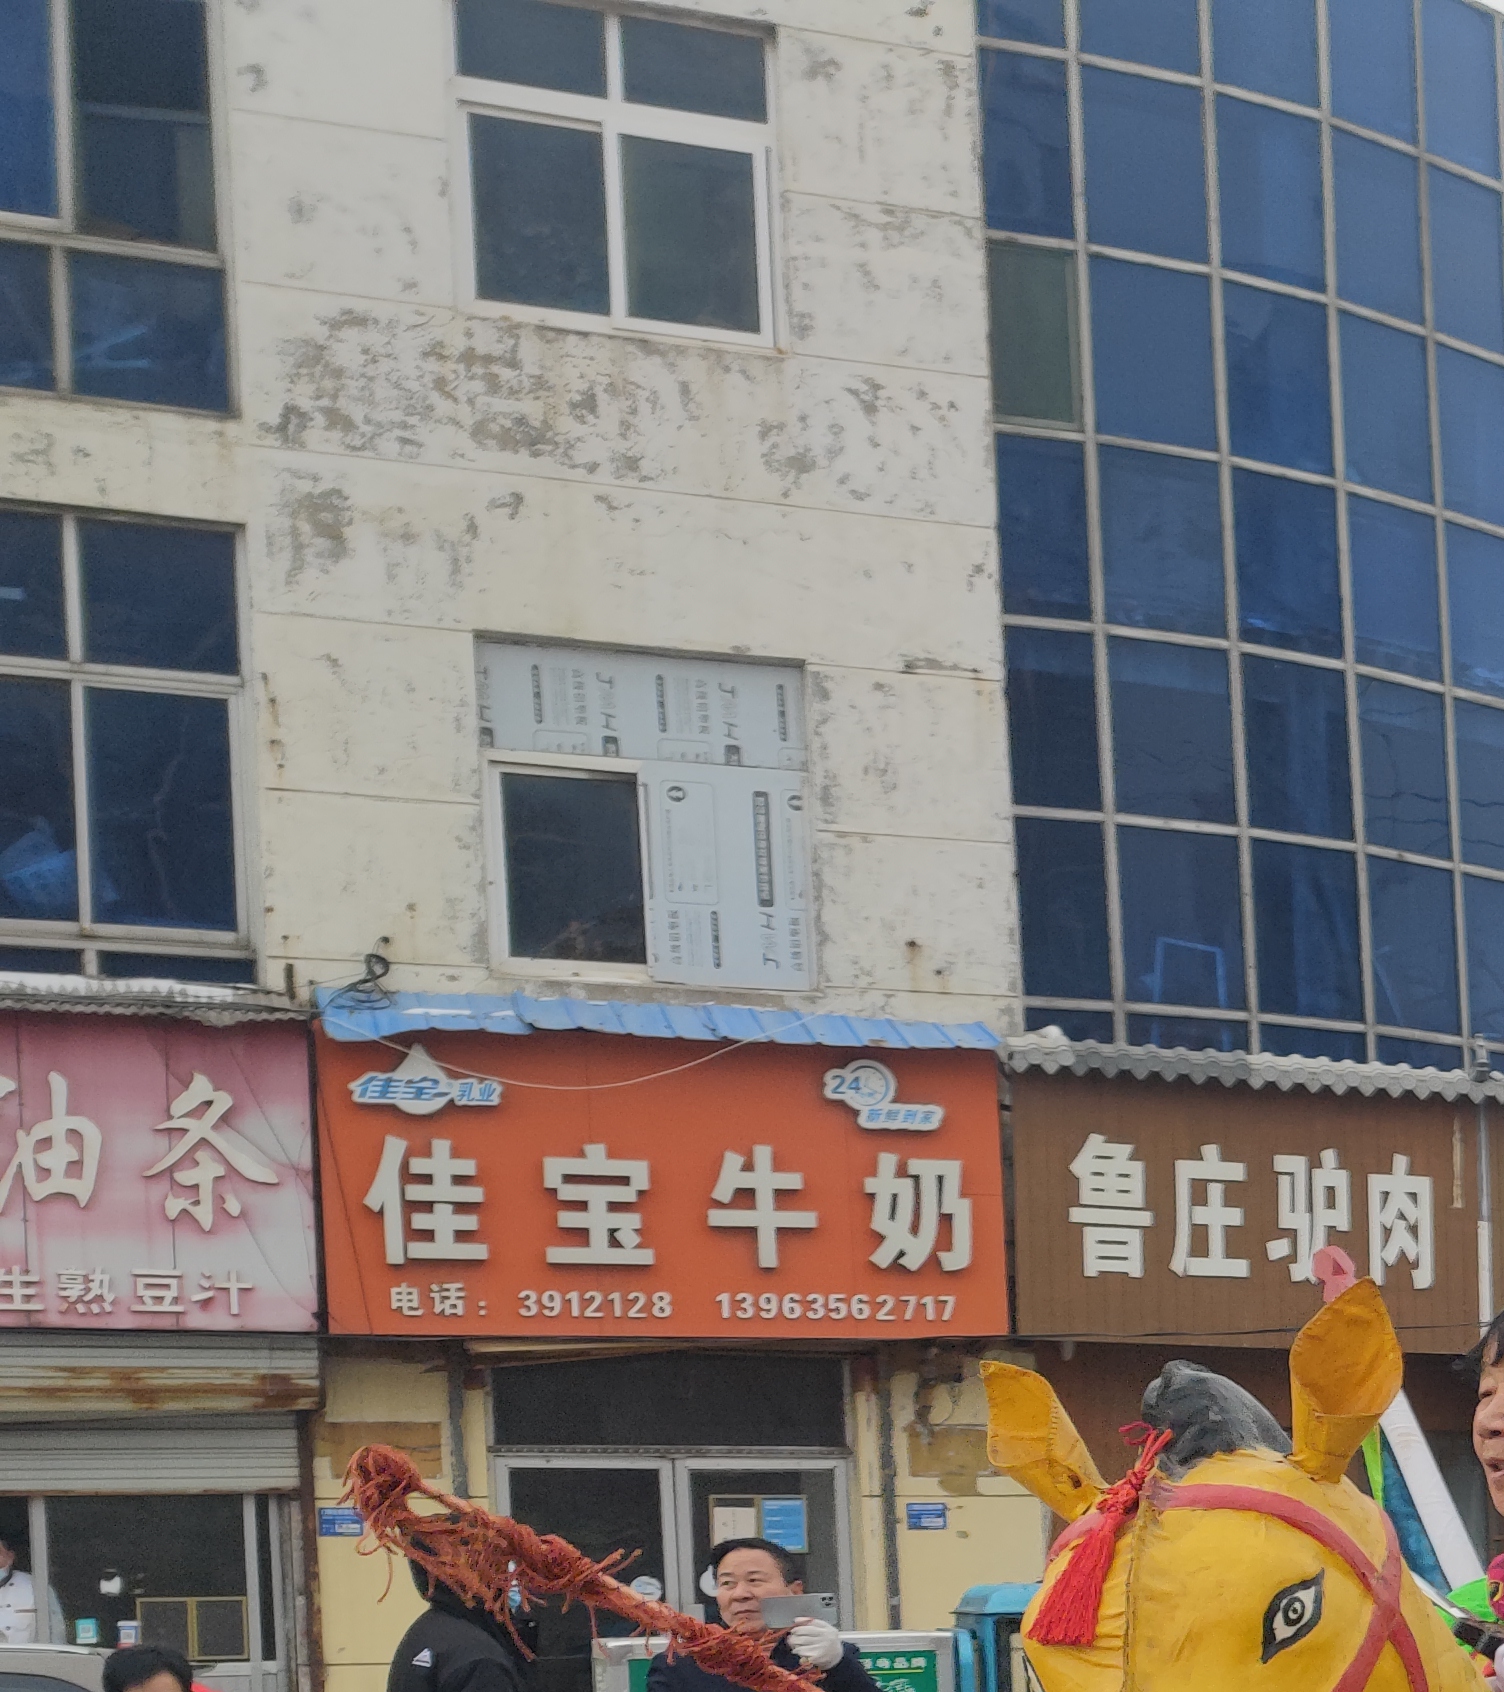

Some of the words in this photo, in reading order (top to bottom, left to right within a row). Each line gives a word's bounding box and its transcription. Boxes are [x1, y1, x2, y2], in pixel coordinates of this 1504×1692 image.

[357, 1075, 446, 1101] 佳宝
[457, 1082, 497, 1102] 乳业
[831, 1074, 862, 1095] 24
[866, 1108, 938, 1125] 新鲜到家
[0, 1071, 279, 1233] 油条
[363, 1134, 973, 1272] 佳宝牛奶
[1068, 1133, 1436, 1291] 鲁庄驴肉
[0, 1265, 253, 1316] 生熟豆汁
[517, 1289, 673, 1319] 3912128
[714, 1291, 957, 1322] 13963562717
